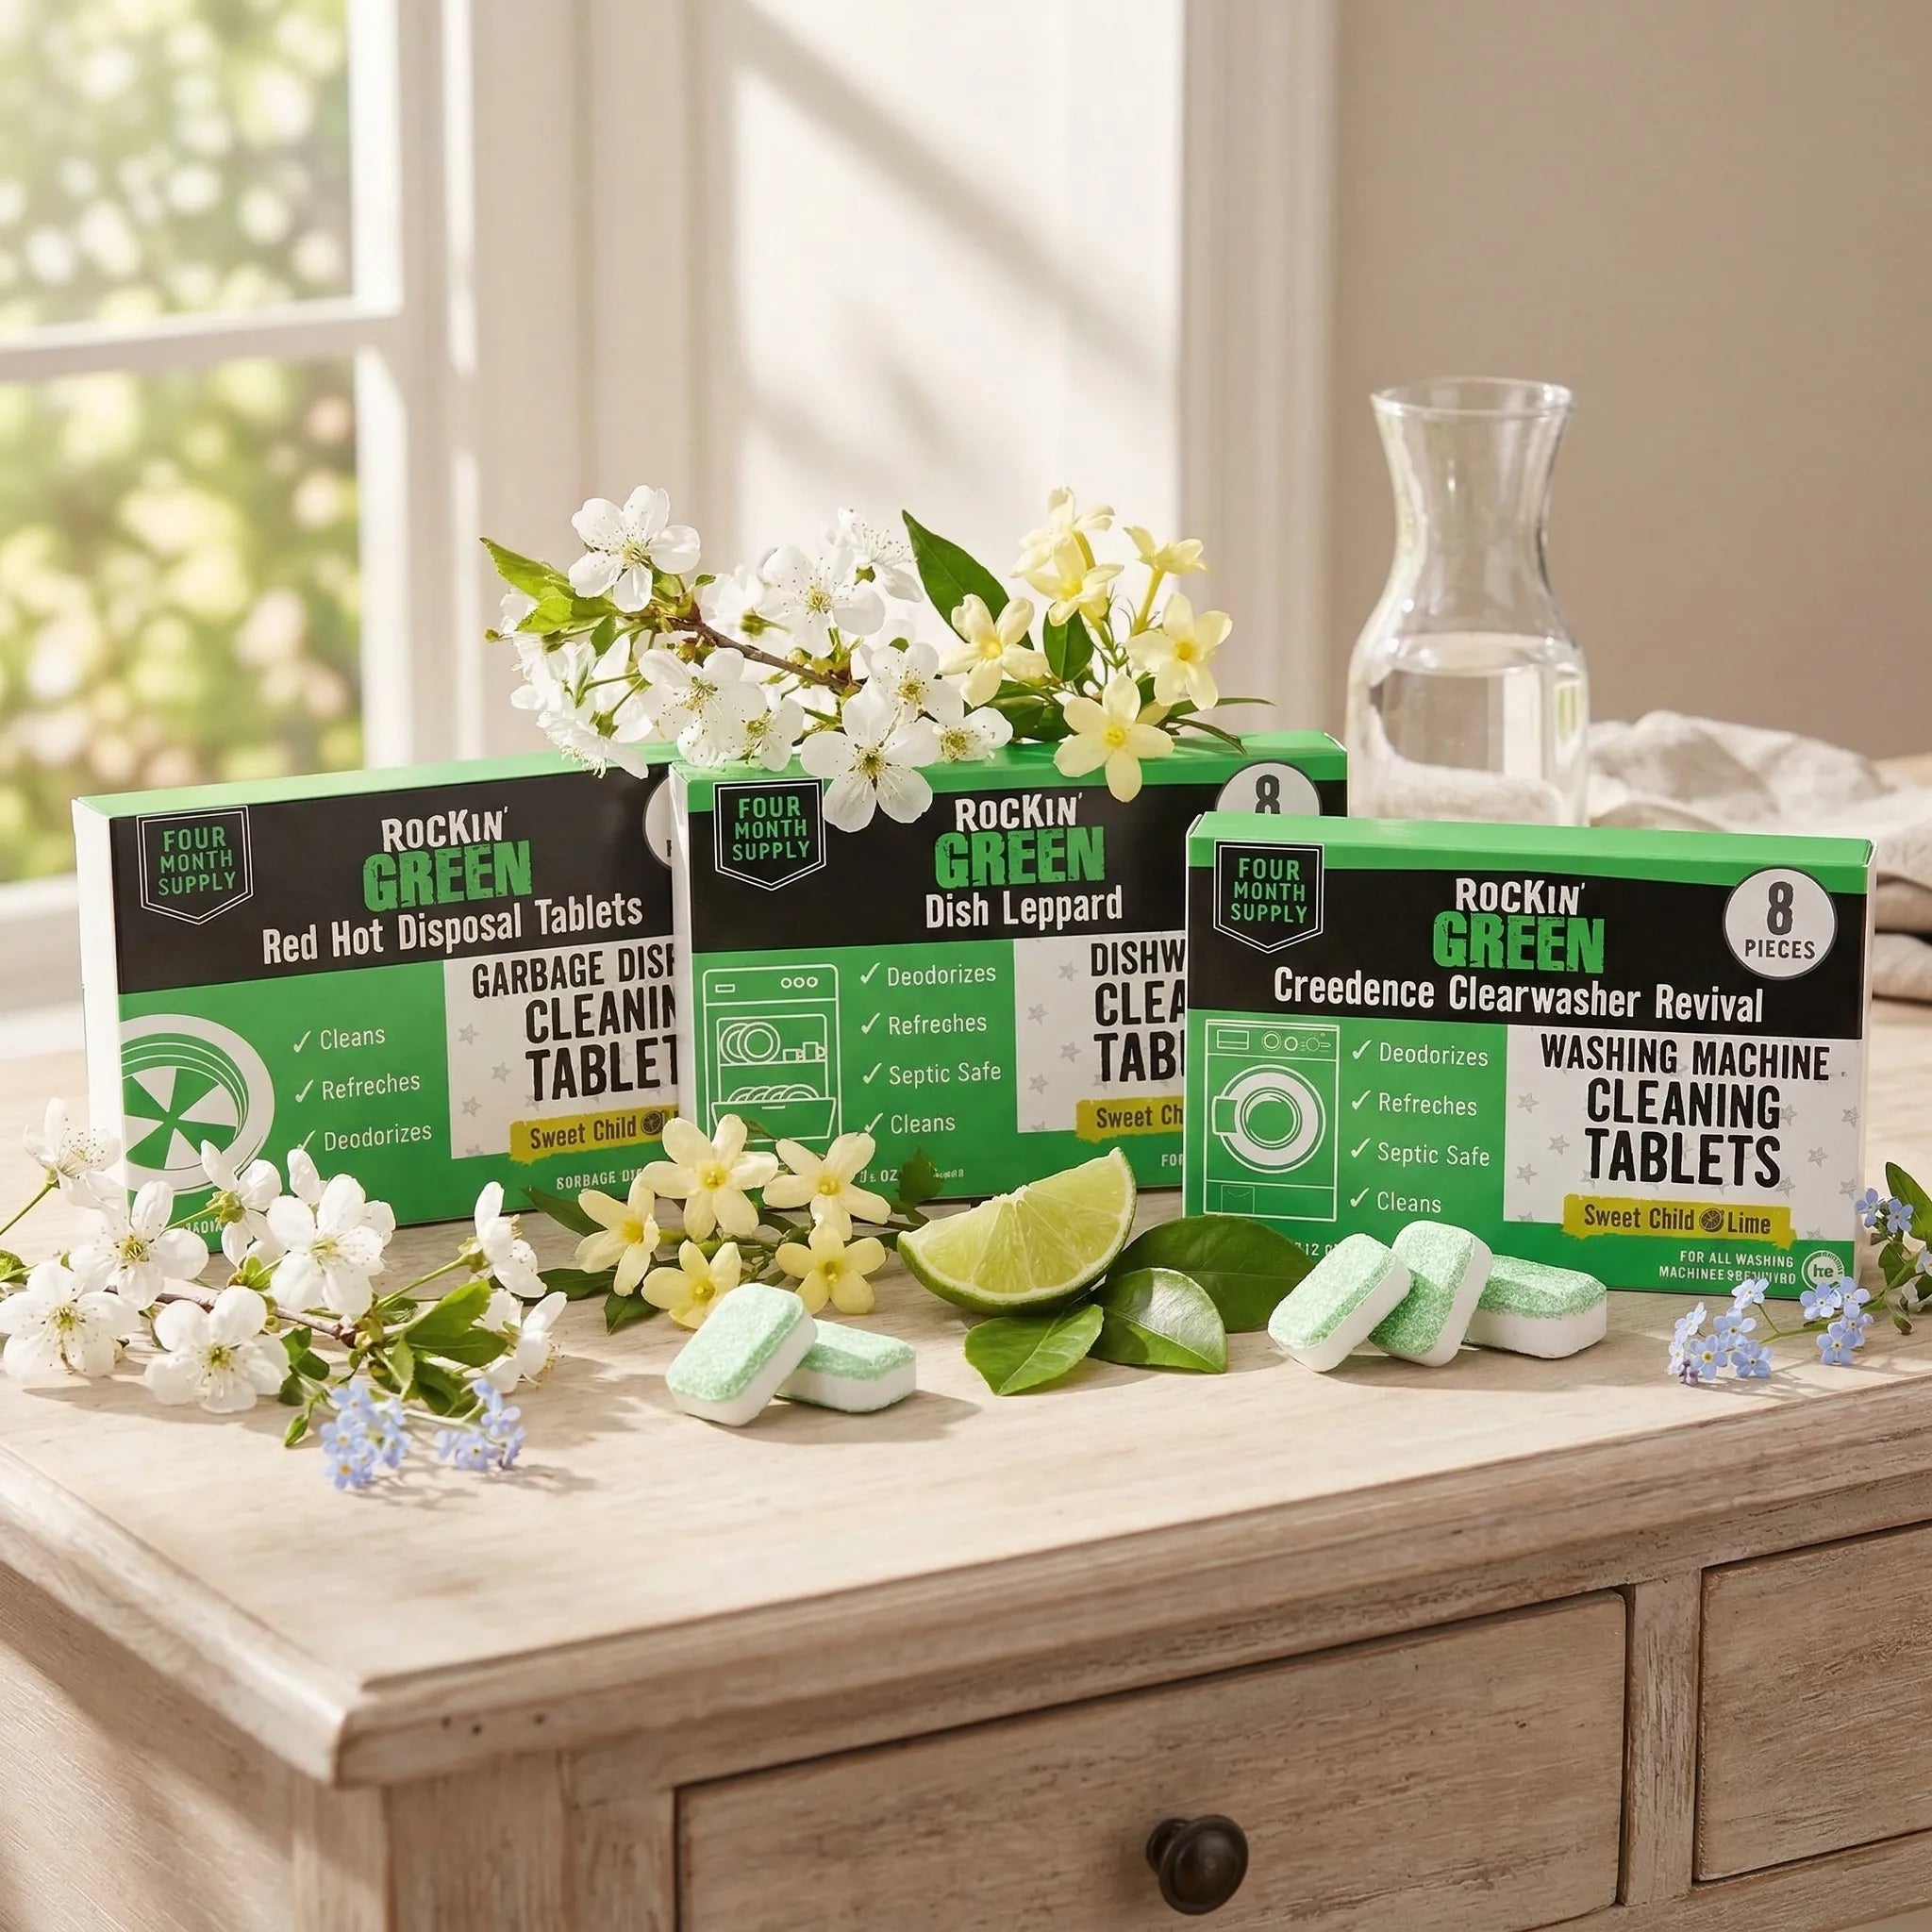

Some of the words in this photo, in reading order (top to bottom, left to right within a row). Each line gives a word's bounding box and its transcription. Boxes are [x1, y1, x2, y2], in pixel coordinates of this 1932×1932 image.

[739, 795, 801, 819] FOUR
[1255, 774, 1281, 814] 8
[162, 825, 226, 852] FOUR
[735, 819, 808, 840] MONTH
[159, 849, 233, 874] MONTH
[732, 840, 810, 861] SUPPLY
[935, 826, 1105, 889] GREEN
[362, 840, 533, 912] GREEN
[1239, 858, 1300, 881] FOUR
[158, 872, 236, 896] SUPPLY
[1234, 881, 1306, 902] MONTH
[925, 891, 989, 928] Dish
[1003, 885, 1123, 931] Leppard
[1230, 903, 1307, 924] SUPPLY
[1766, 880, 1793, 936] 8
[262, 924, 318, 964] Red
[331, 919, 384, 958] Hot
[398, 903, 522, 955] Disposal
[535, 892, 643, 936] Tablets
[1433, 910, 1605, 974] GREEN
[1744, 939, 1815, 959] PIECES
[1091, 939, 1186, 976] DISHW
[473, 951, 605, 999] GARBAGE
[887, 963, 996, 987] Deodorizes
[1274, 966, 1435, 1008] Creedence
[1449, 974, 1641, 1018] Clearwasher
[1656, 983, 1763, 1023] Revival
[320, 1028, 386, 1050] Cleans
[1379, 1041, 1489, 1067] Deodorizes
[1541, 1033, 1678, 1074] WASHING
[1692, 1041, 1830, 1081] MACHINE
[322, 1073, 421, 1101] Refreches
[889, 1063, 951, 1089] Septic
[958, 1060, 1002, 1082] Safe
[1378, 1091, 1477, 1116] Refreches
[1588, 1077, 1780, 1130] CLEANING
[891, 1113, 956, 1134] Cleans
[1095, 1107, 1153, 1129] Sweet
[325, 1123, 432, 1152] Deodorizes
[530, 1123, 586, 1150] Sweet
[593, 1115, 637, 1141] Child
[1377, 1141, 1439, 1167] Septic
[1446, 1144, 1491, 1167] Safe
[1585, 1127, 1781, 1189] TABLETS
[1377, 1191, 1441, 1213] Cleans
[1584, 1204, 1641, 1228] Sweet
[1649, 1208, 1694, 1231] Child
[1728, 1211, 1771, 1234] Lime
[1680, 1250, 1704, 1263] FOR
[1708, 1252, 1731, 1264] ALL
[1736, 1253, 1793, 1268] WASHING
